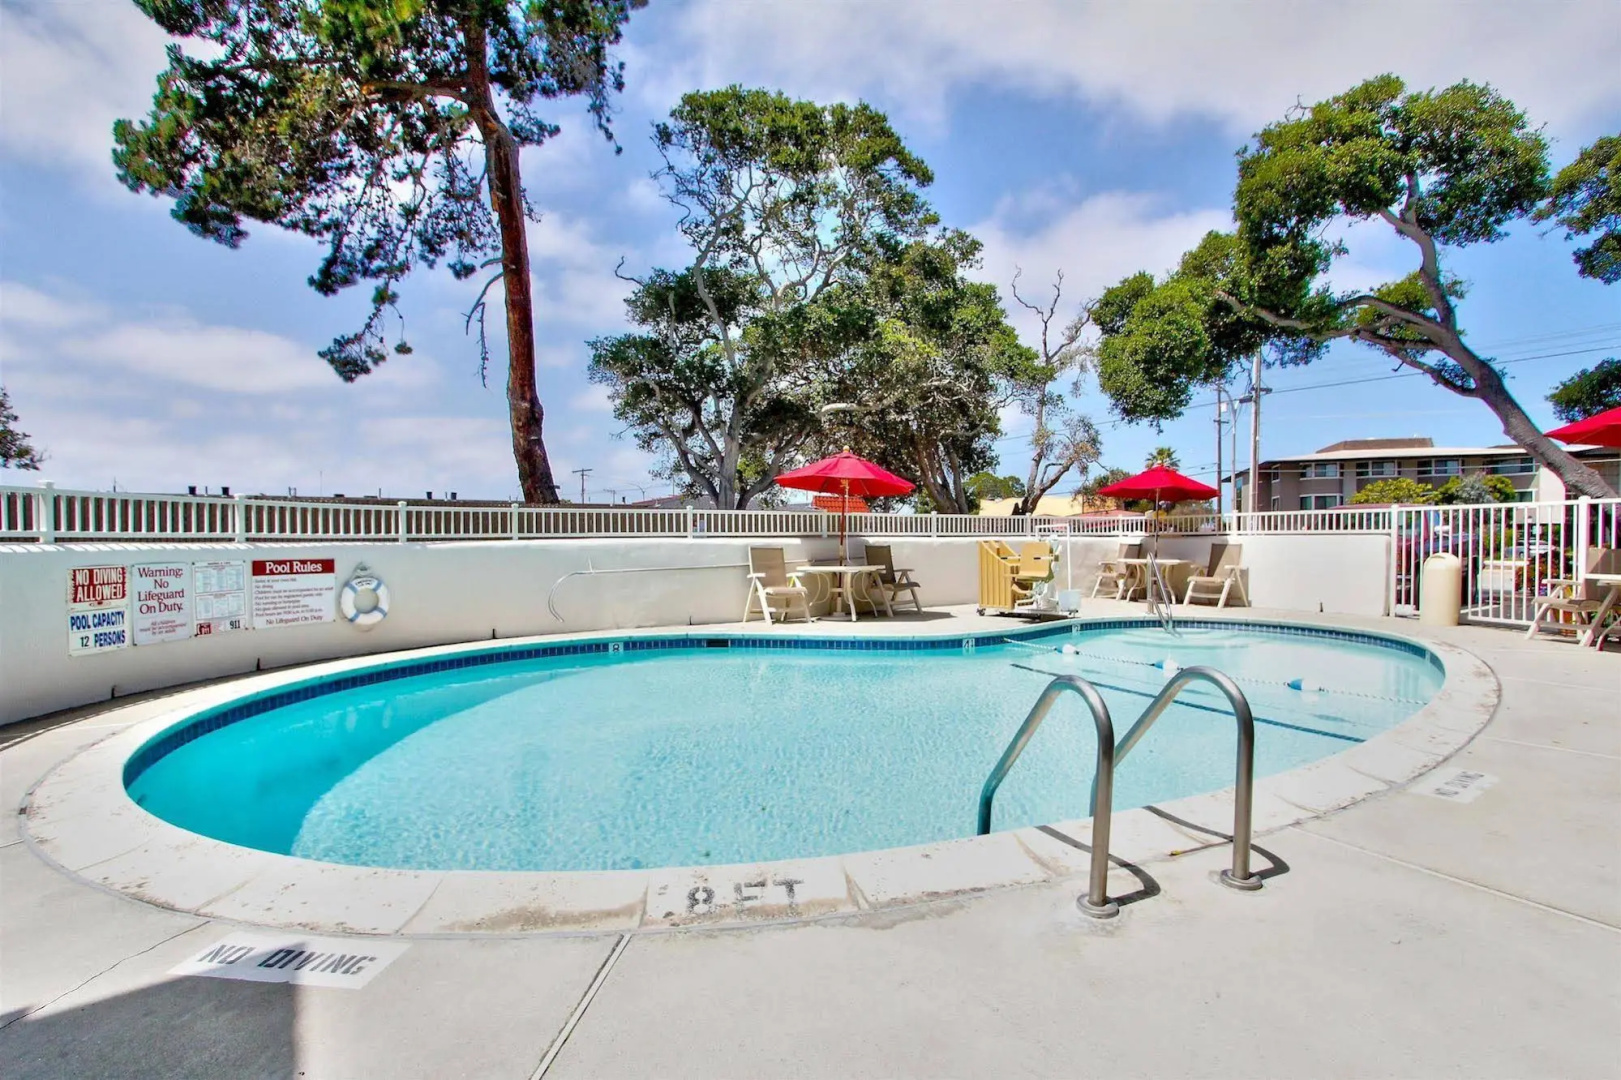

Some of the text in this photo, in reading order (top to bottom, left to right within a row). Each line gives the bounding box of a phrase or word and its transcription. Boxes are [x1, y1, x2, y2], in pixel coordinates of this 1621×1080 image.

[265, 560, 323, 574] Pool Rules
[75, 567, 123, 586] NO DIVING
[153, 578, 170, 590] No
[76, 584, 123, 602] ALLOWED
[137, 588, 185, 603] Lifeguard
[139, 603, 157, 615] On
[70, 610, 125, 631] POOL CAPACITY
[229, 619, 241, 630] 911
[275, 616, 300, 625] Lifeguard
[80, 629, 126, 648] 12 PERSONS
[197, 943, 378, 976] NO DIVING
